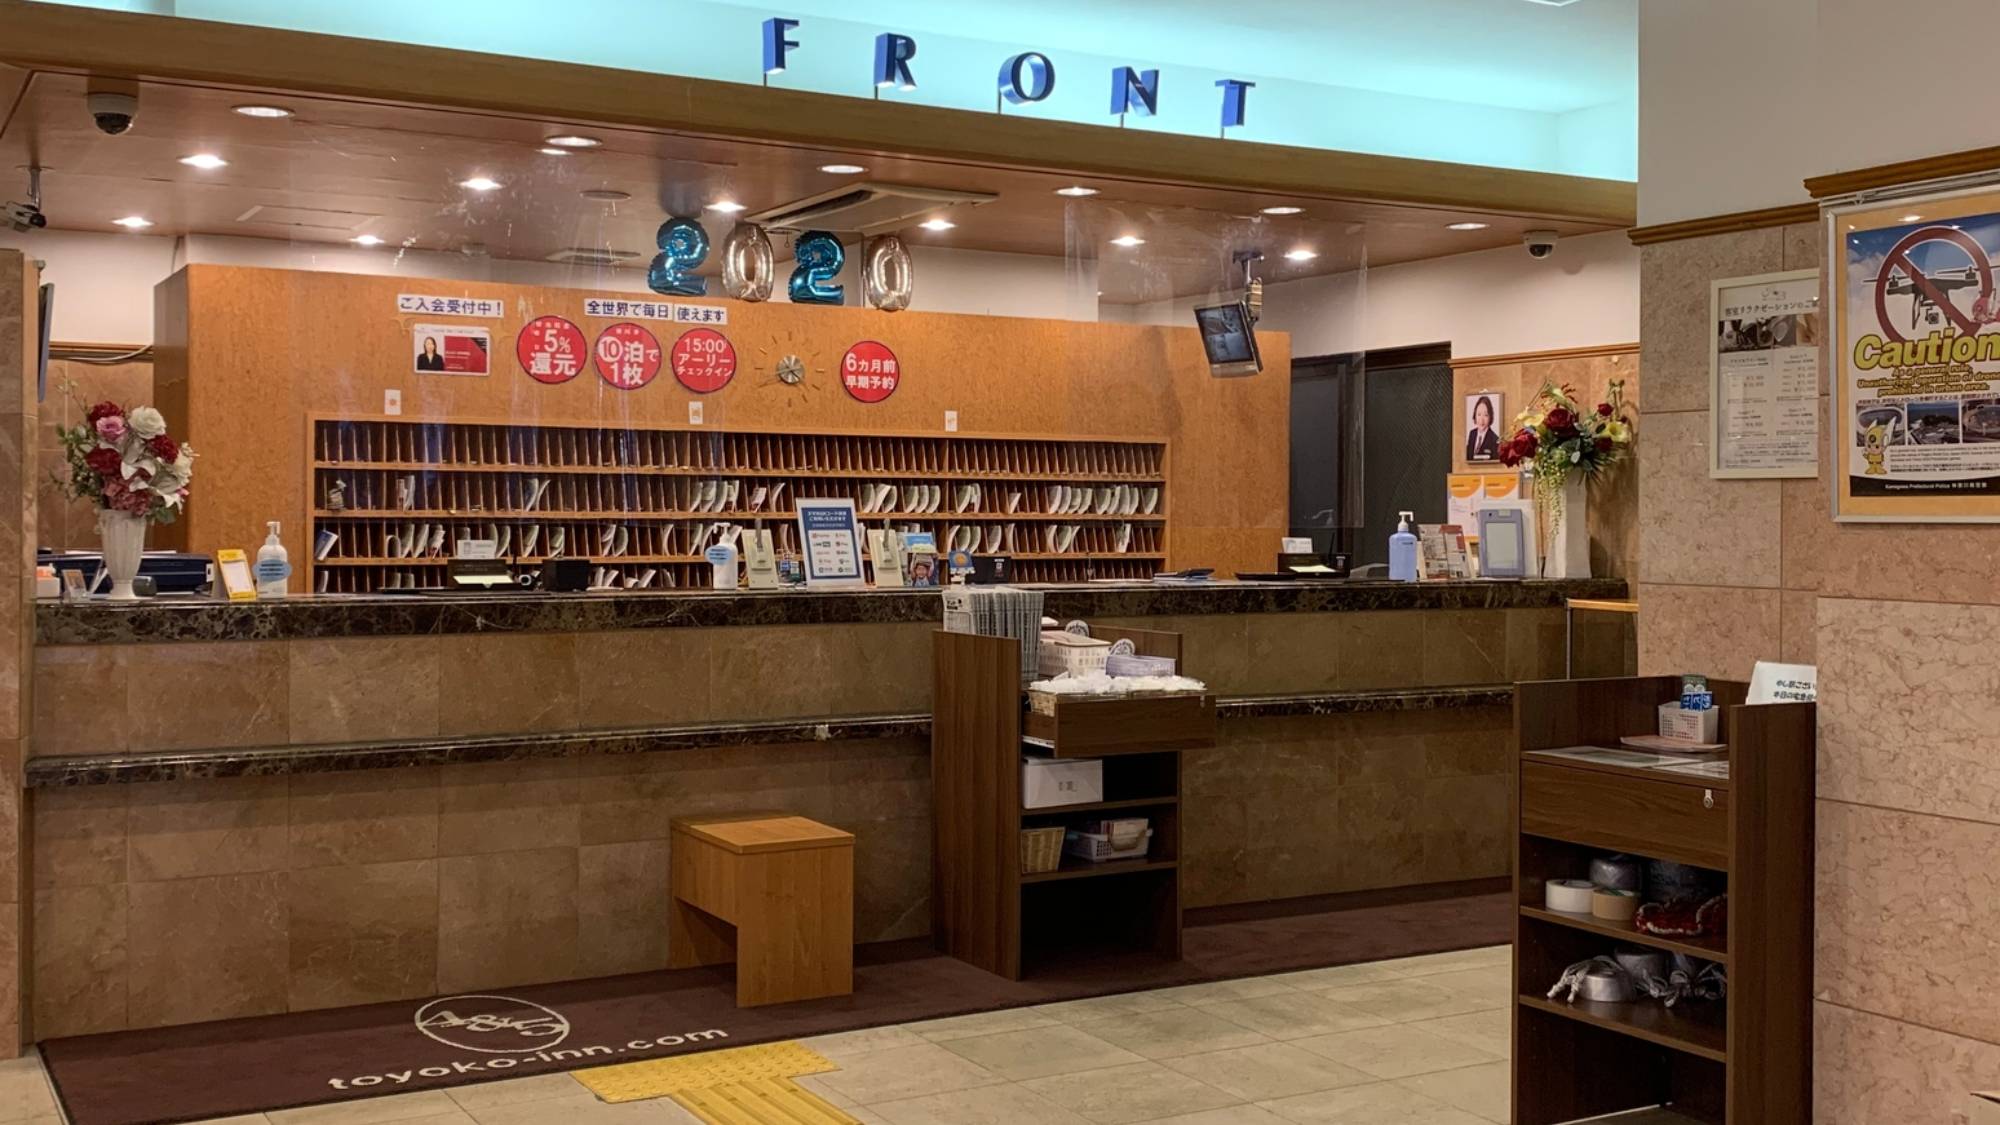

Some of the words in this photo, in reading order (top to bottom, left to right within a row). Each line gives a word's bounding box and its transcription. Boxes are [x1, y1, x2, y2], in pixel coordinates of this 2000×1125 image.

[763, 17, 1256, 127] FRONT
[648, 216, 914, 312] 2020
[587, 300, 669, 319] 全世界で毎日
[677, 306, 726, 323] 使えます
[543, 328, 572, 353] 5%
[684, 337, 726, 353] 15:00
[1854, 327, 2000, 370] Caution
[529, 352, 577, 377] 還元
[676, 366, 733, 377] チェックイン
[678, 353, 732, 367] アーリー
[609, 363, 644, 386] 1枚
[845, 374, 895, 390] 早期予約
[1961, 370, 1974, 382] of
[1935, 382, 1963, 393] urban
[328, 1026, 728, 1091] toyoko-inn.com
